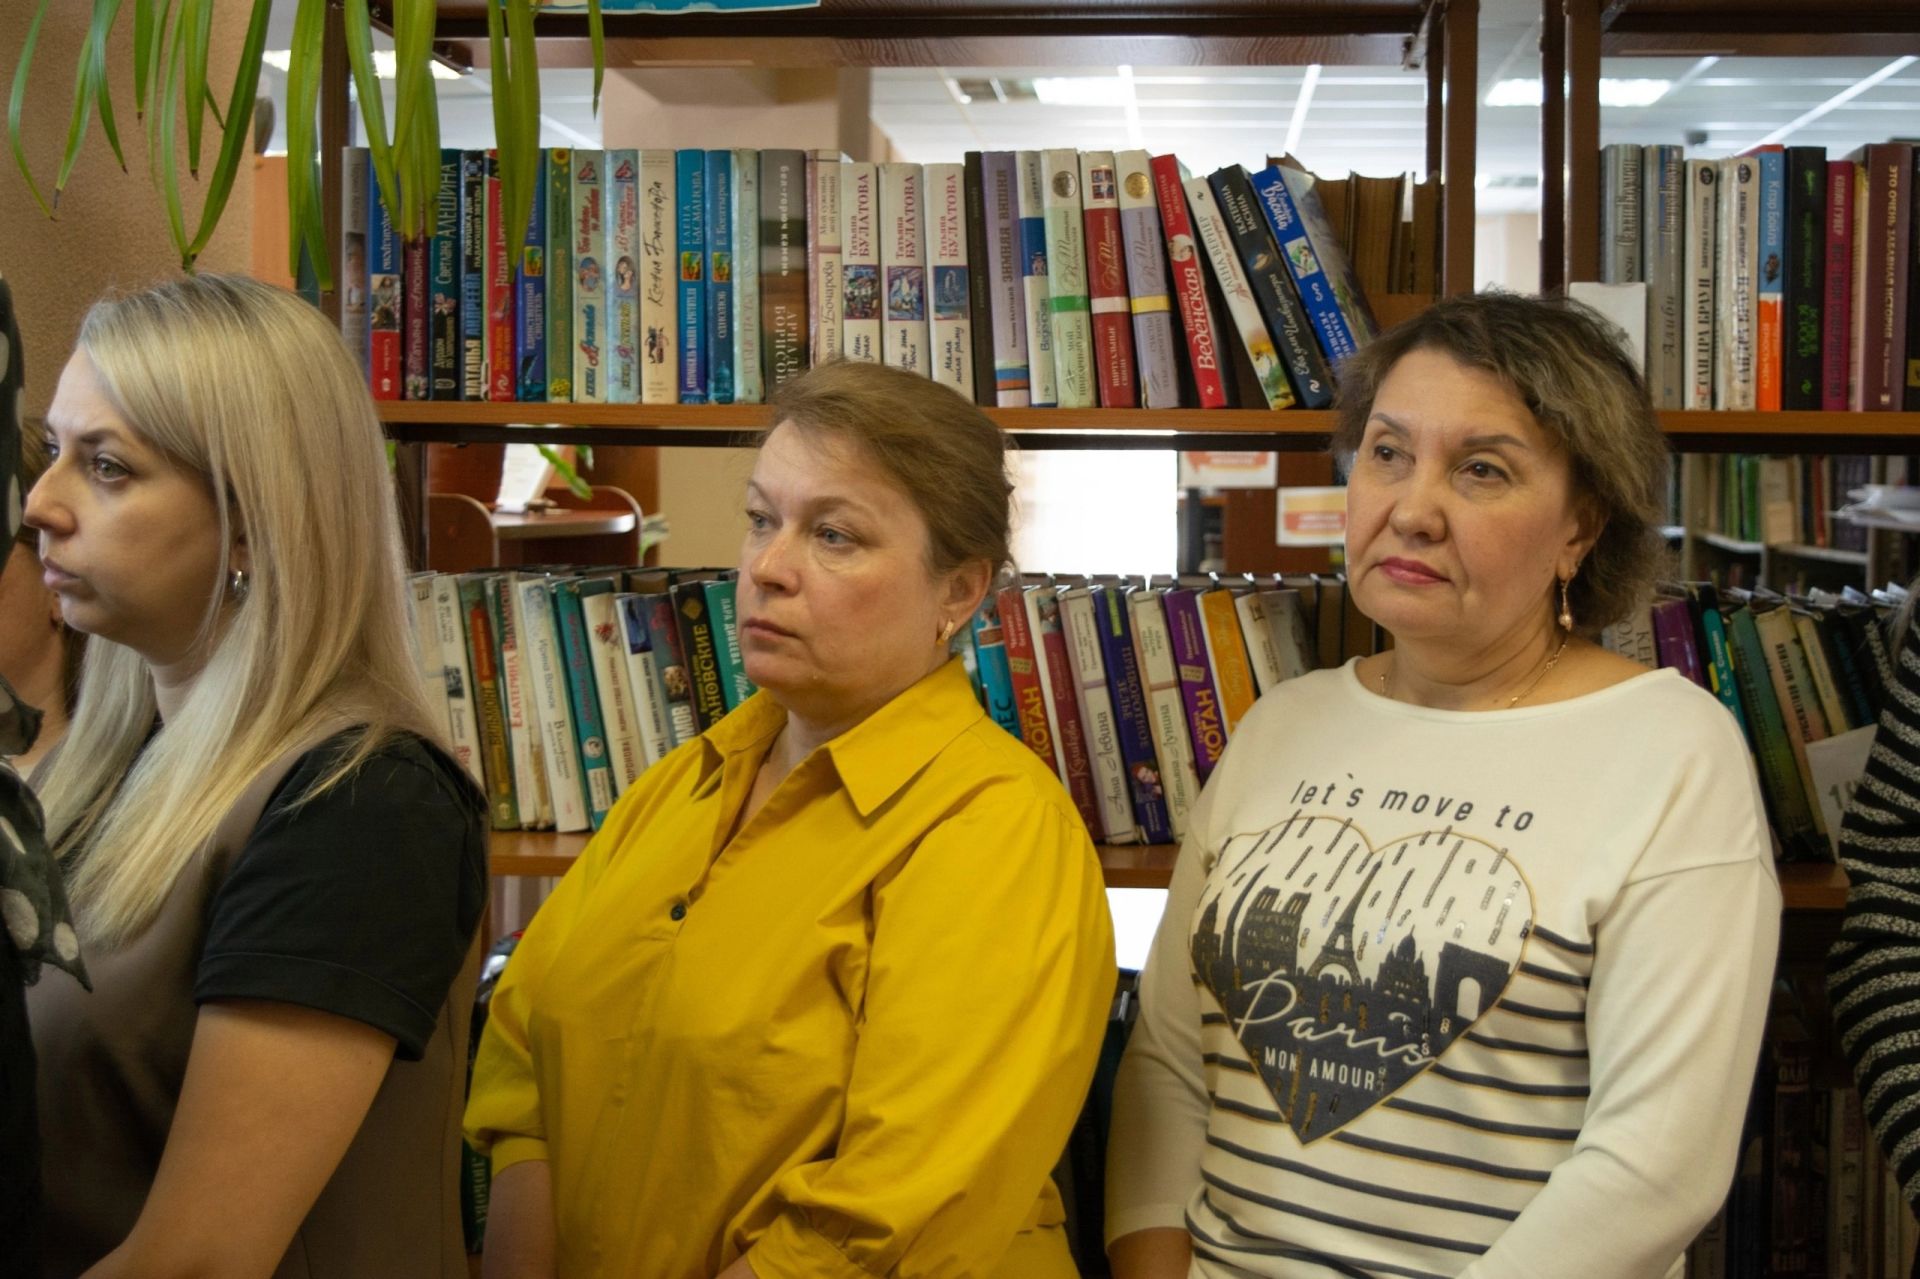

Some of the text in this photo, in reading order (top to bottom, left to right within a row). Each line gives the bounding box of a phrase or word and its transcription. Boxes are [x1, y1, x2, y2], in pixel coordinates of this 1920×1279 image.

[997, 169, 1010, 220] ВИШНЯ
[1767, 180, 1780, 209] Клэр
[1888, 164, 1899, 187] ЭТО
[435, 163, 458, 285] Светлана АЛЕШИНА
[857, 173, 870, 258] БУЛАТОВА
[904, 175, 915, 259] БУЛАТОВА
[947, 173, 959, 258] БУЛАТОВА
[1221, 184, 1248, 236] ЕКАТЕРИНА
[1237, 194, 1257, 232] ВАСИНА
[1261, 180, 1288, 231] Васина
[1833, 175, 1845, 236] КОЛИН ГУВЕР
[1887, 191, 1898, 226] ОЧЕНЬ
[779, 232, 790, 277] камень
[849, 215, 858, 258] Татьяна
[895, 216, 904, 259] Татьяна
[938, 215, 947, 259] Татьяна
[1001, 227, 1013, 283] ЗИМНЯЯ
[1885, 228, 1896, 285] ЗАБАВНАЯ
[820, 261, 837, 324] Бочарова
[1184, 267, 1216, 371] Веденская
[1698, 278, 1711, 325] БРАУН
[1884, 287, 1895, 338] ИСТОРИЯ
[465, 273, 481, 396] НАТАЛЬЯ АНДРЕЕВА
[944, 340, 954, 373] Мама
[953, 326, 964, 385] мыла раму
[1698, 330, 1711, 386] САНДРА
[500, 580, 523, 729] ЕКАТЕРИНА ВИЛЬМОНТ
[538, 638, 551, 671] Ирина
[1005, 614, 1017, 649] Человек
[693, 623, 723, 724] РАНОВСКИЕ
[1117, 679, 1131, 721] ЗЕЛЬЕ
[1121, 646, 1148, 749] ПРИВОРОТНОЕ
[1022, 686, 1050, 758] КОГАН
[1096, 711, 1117, 771] Левина
[1159, 703, 1179, 760] Лунина
[1196, 688, 1222, 762] КОГАН
[1380, 788, 1475, 822] move
[1495, 804, 1535, 832] to
[1235, 969, 1438, 1066] Paris
[1264, 1045, 1376, 1092] MON AMOUR
